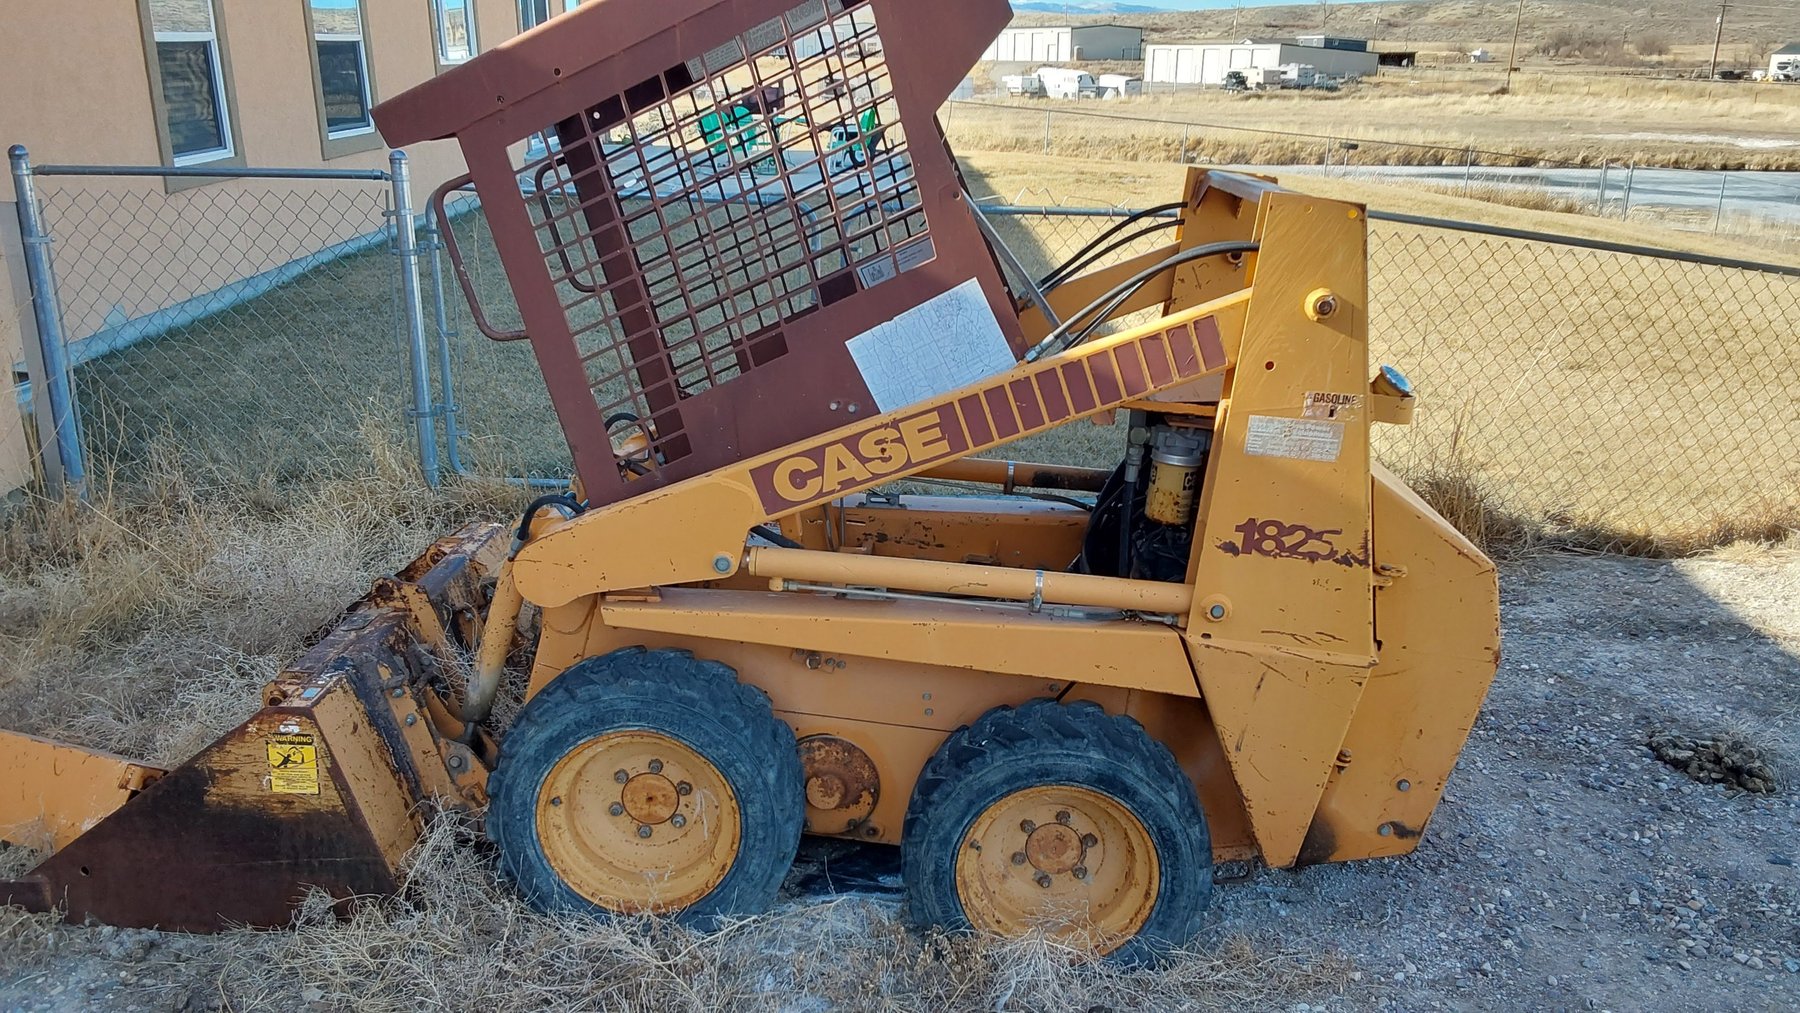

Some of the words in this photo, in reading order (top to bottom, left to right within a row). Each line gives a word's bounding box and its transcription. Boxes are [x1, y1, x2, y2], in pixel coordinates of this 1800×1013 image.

[1313, 392, 1357, 405] GASOLINE
[773, 410, 951, 502] CASE
[1234, 517, 1343, 561] 1825
[274, 735, 312, 743] WARNING
